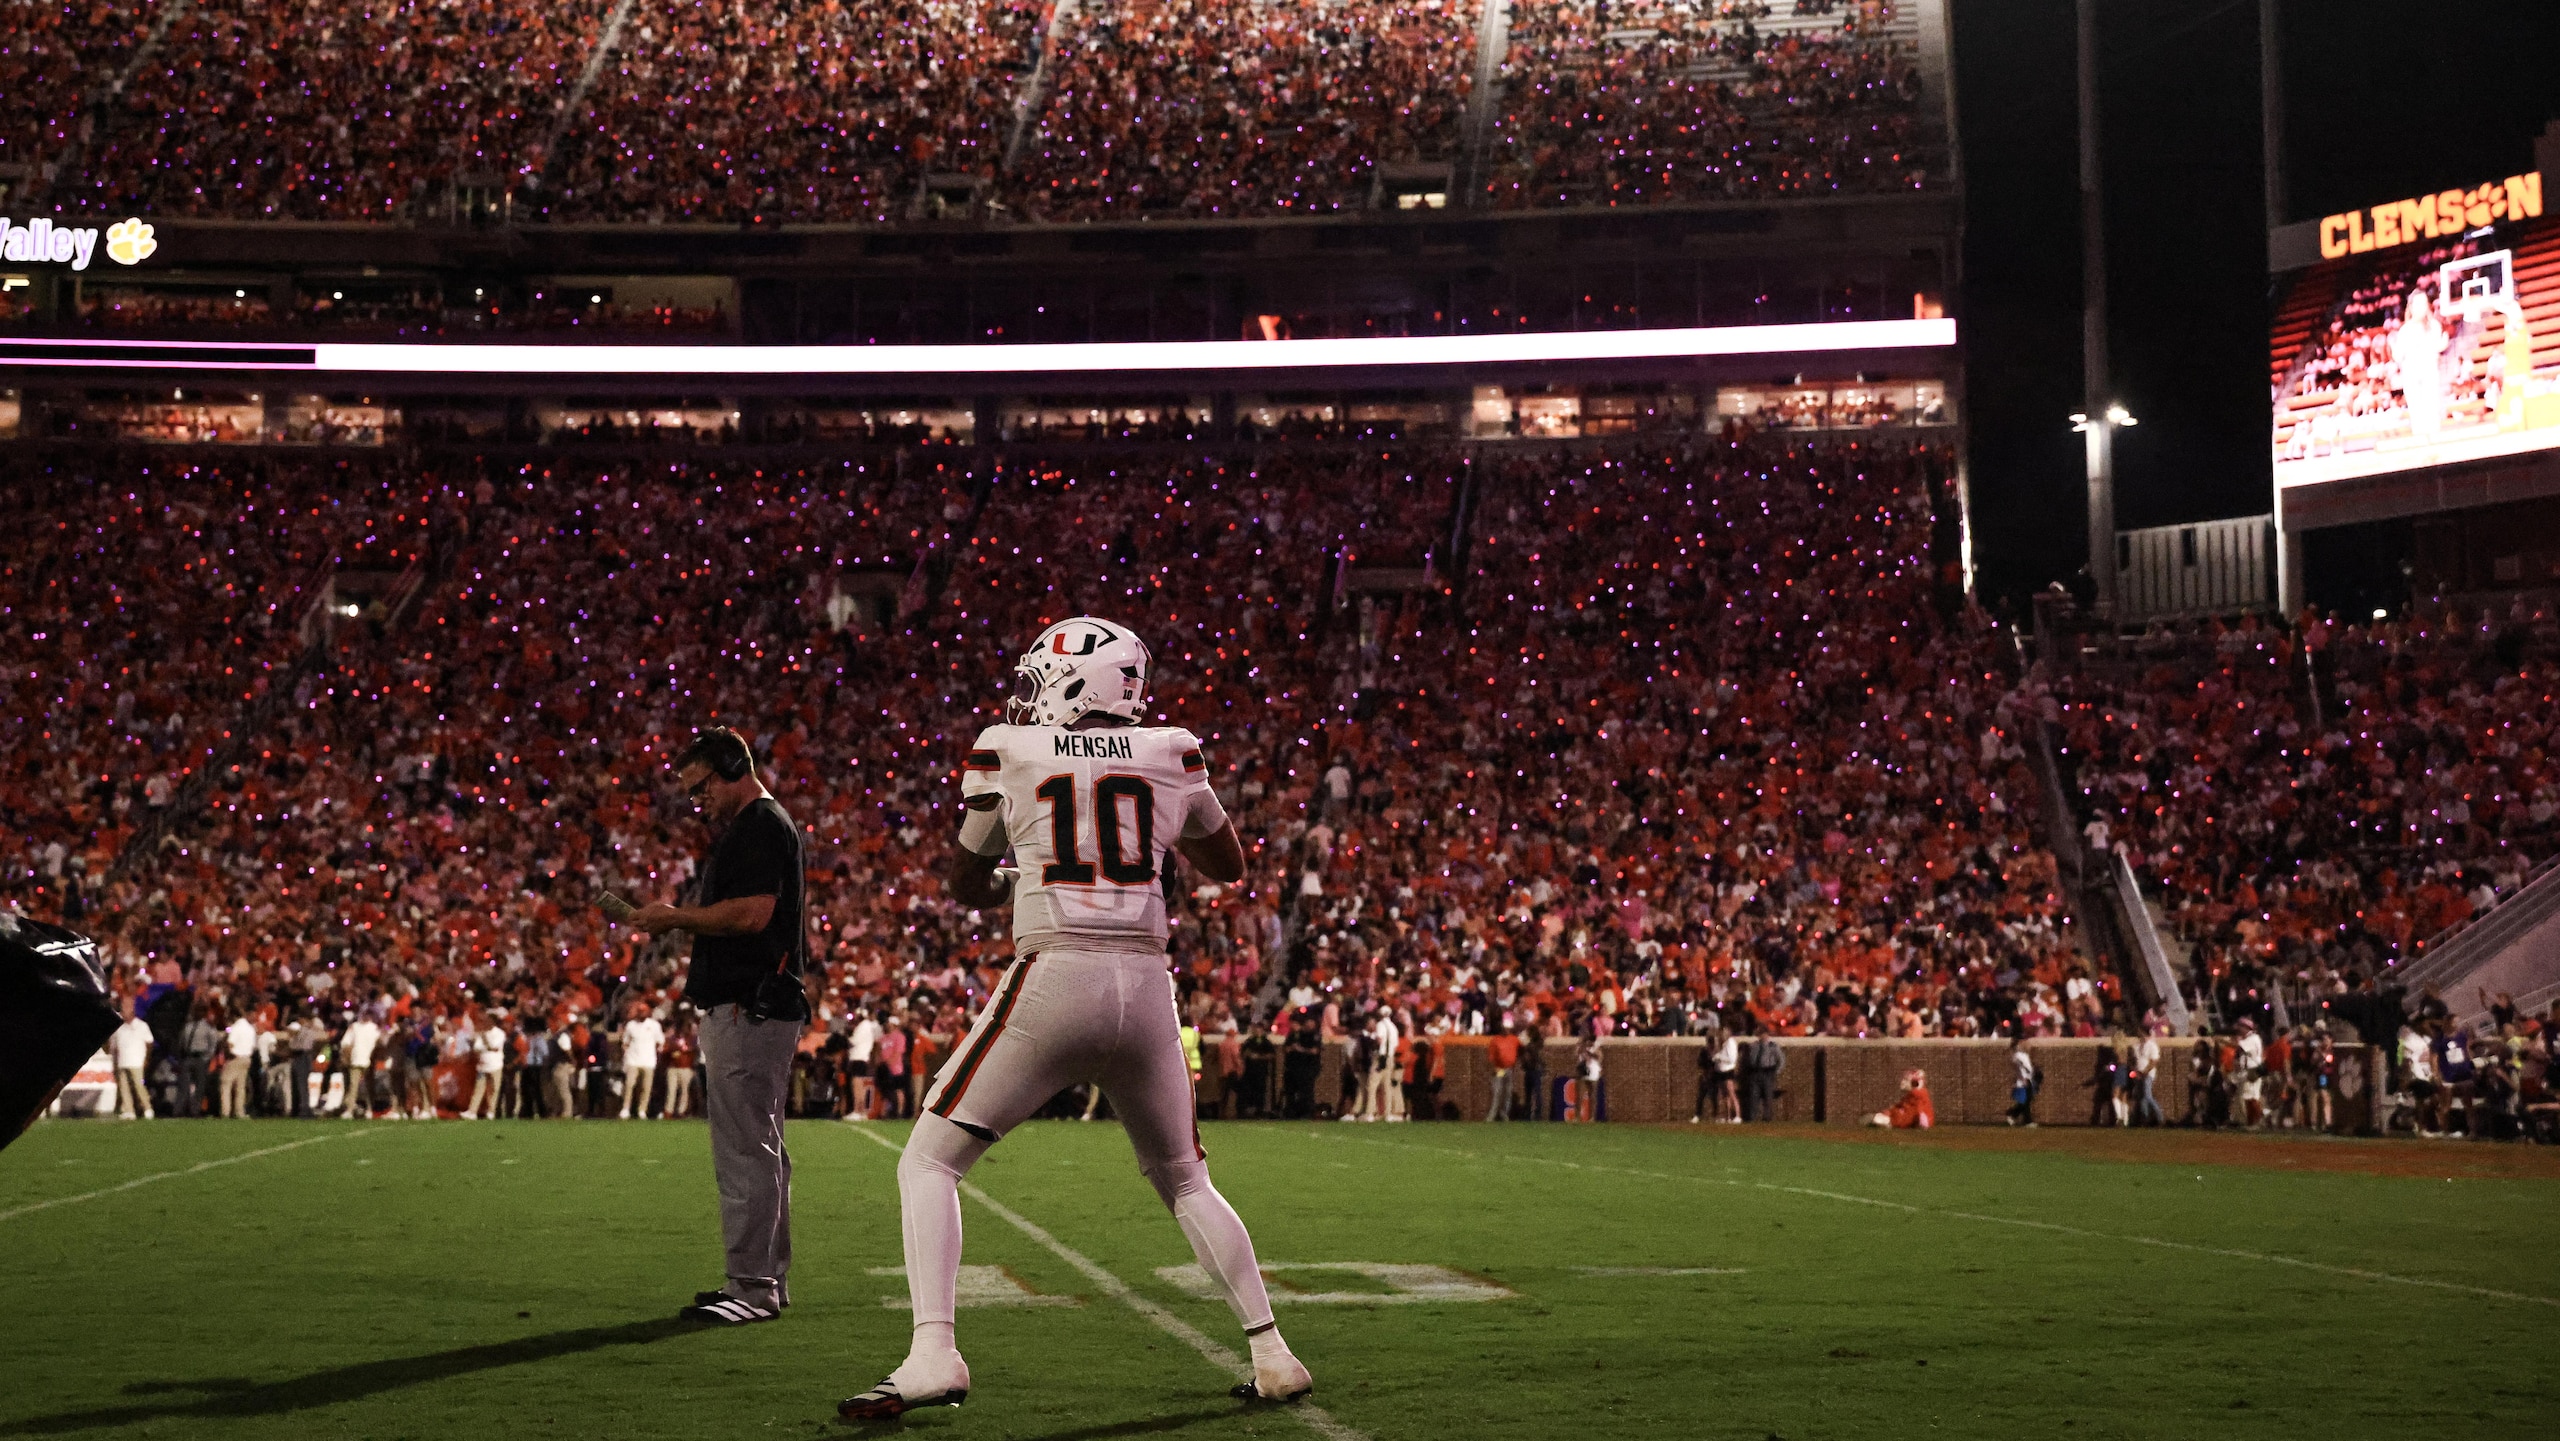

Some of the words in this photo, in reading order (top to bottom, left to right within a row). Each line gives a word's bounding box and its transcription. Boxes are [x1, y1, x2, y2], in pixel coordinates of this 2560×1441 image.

[1052, 633, 1097, 656] U
[1122, 688, 1133, 701] 10
[1054, 735, 1133, 759] MENSAH
[1035, 772, 1157, 887] 10
